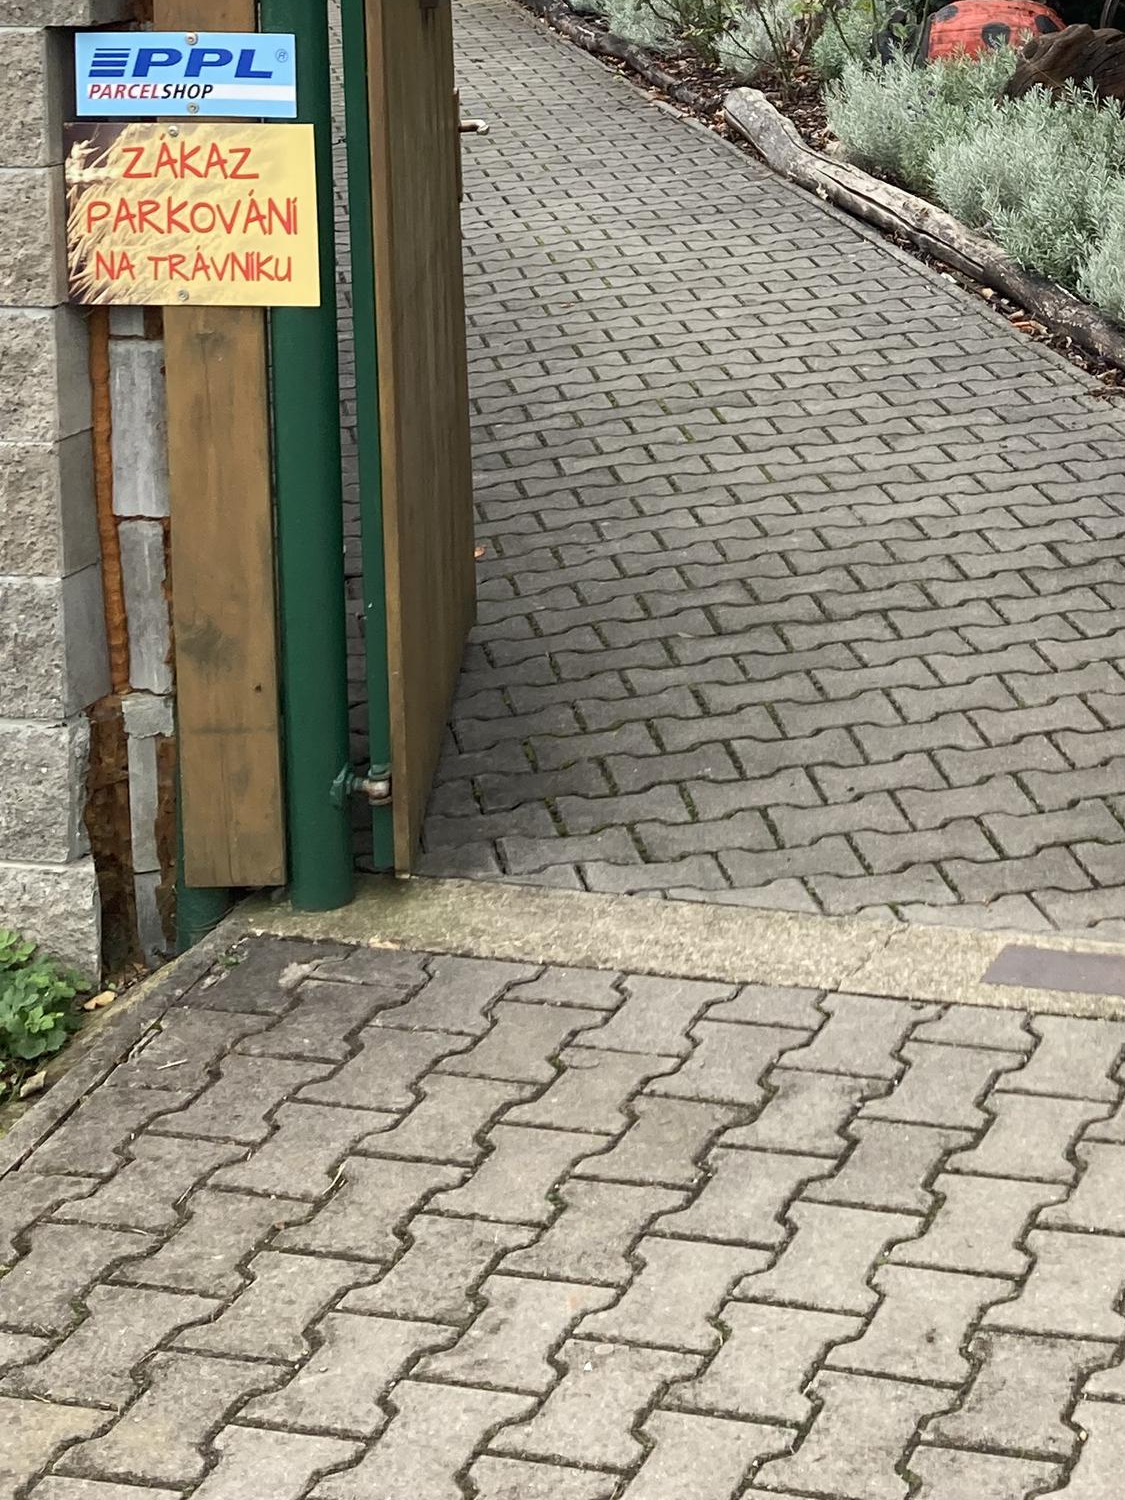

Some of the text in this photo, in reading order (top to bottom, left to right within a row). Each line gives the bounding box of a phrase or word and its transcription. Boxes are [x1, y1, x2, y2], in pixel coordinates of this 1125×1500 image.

[131, 48, 273, 79] PPL
[87, 83, 213, 100] PARCELSHOP
[122, 133, 260, 180] ZÁKAZ
[86, 189, 298, 235] PARKOVÁNÍ
[95, 245, 292, 282] NA TRÁVNÍKU
